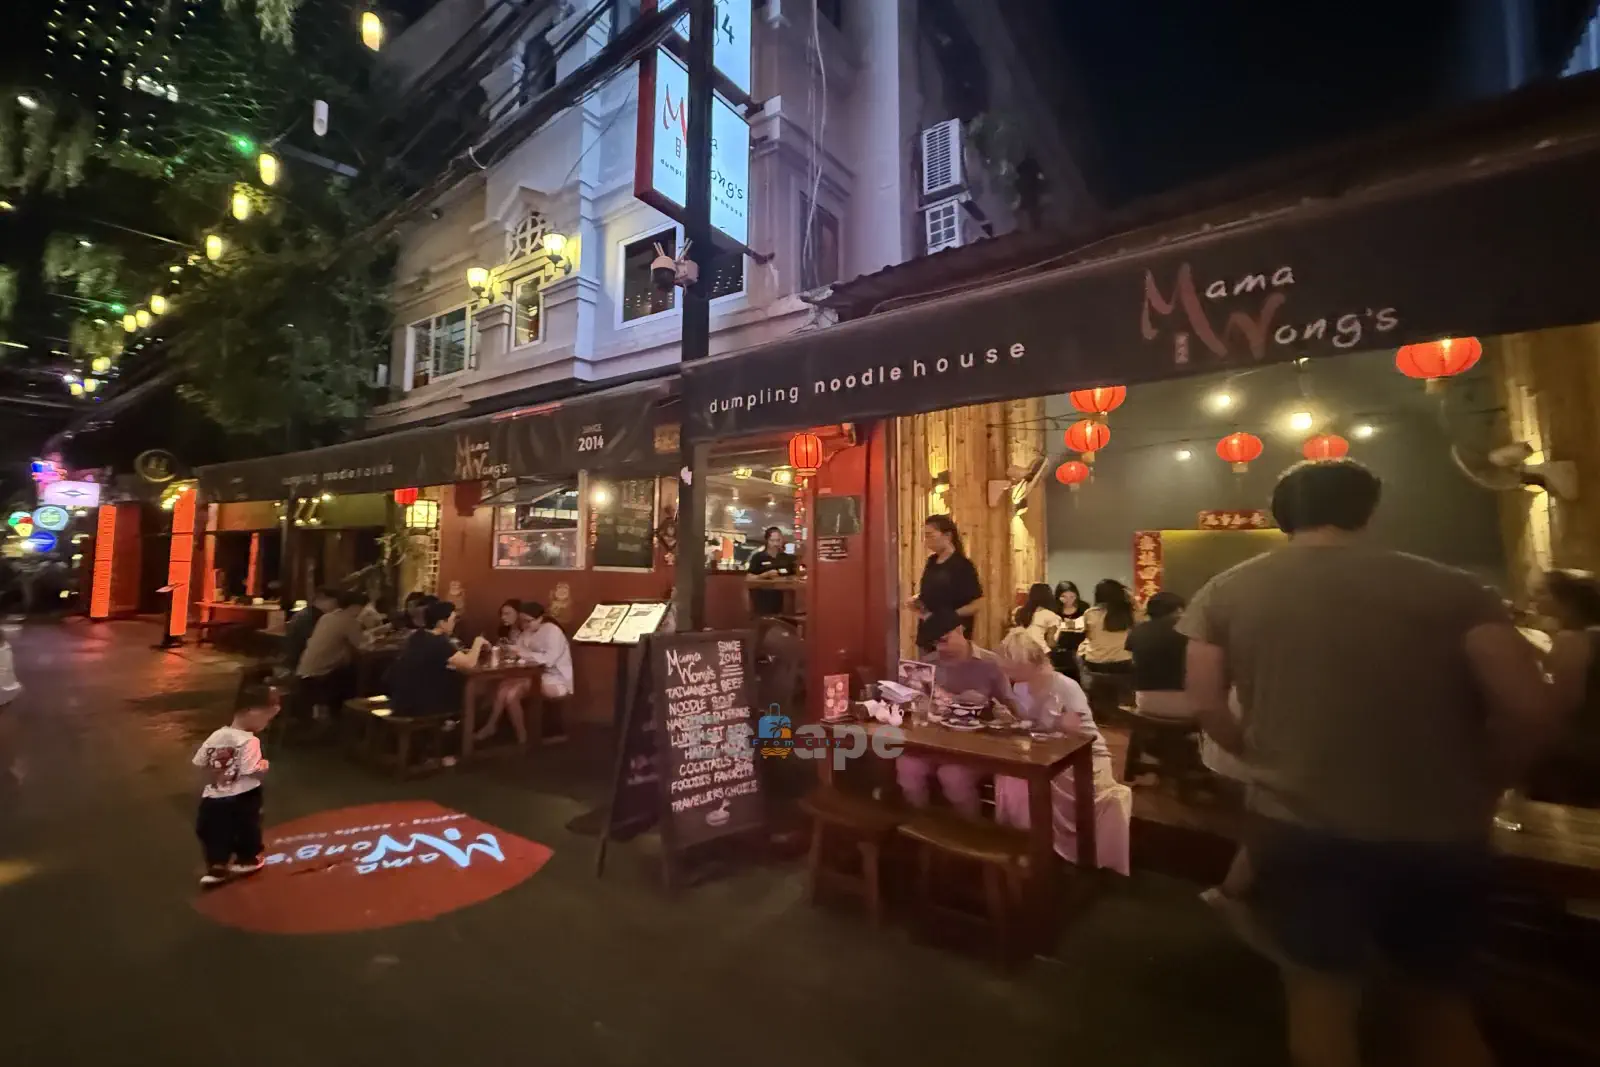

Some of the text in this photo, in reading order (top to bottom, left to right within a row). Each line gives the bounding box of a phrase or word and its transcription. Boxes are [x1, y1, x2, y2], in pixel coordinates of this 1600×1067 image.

[1140, 262, 1295, 358] Mama
[1222, 292, 1399, 360] Wong's
[709, 385, 799, 414] dumpling
[577, 436, 604, 452] 2014
[666, 649, 702, 676] Mama
[668, 698, 707, 716] NOODLE
[679, 755, 732, 777] COCKTAILS
